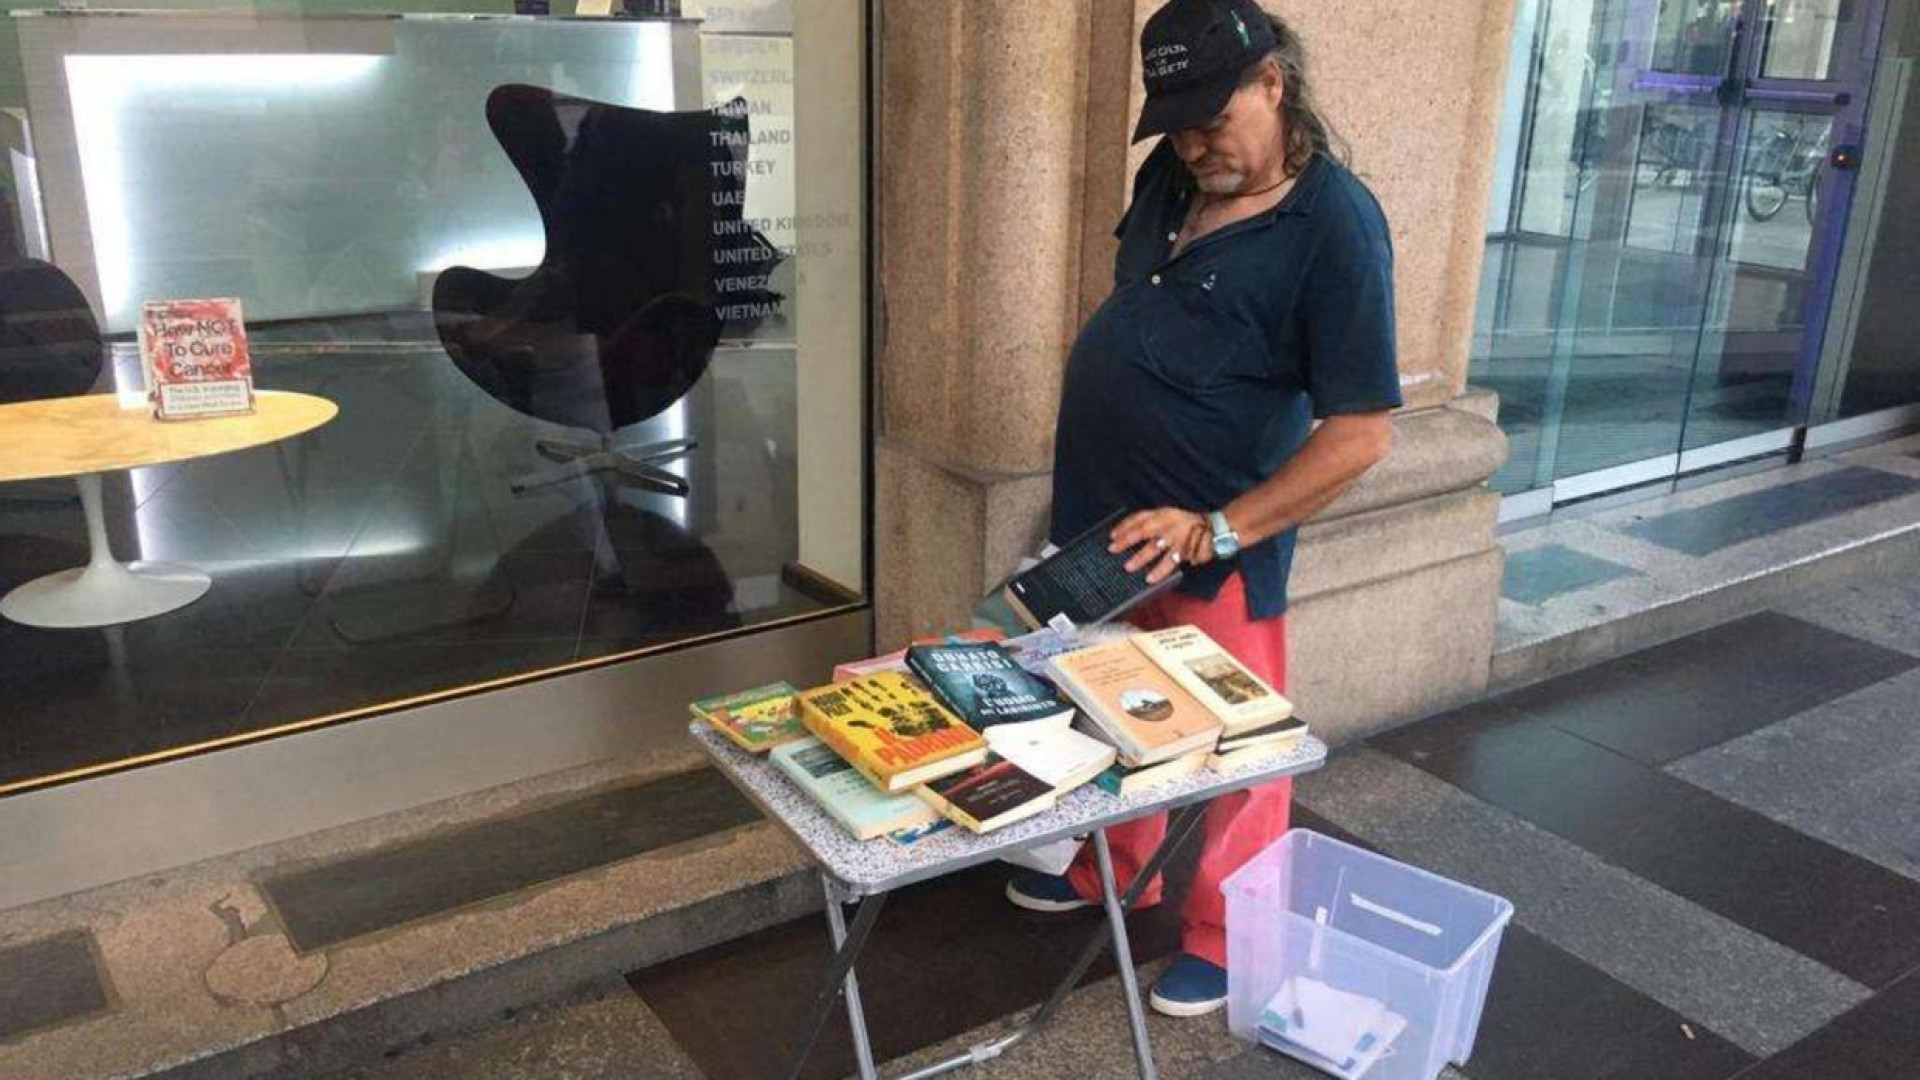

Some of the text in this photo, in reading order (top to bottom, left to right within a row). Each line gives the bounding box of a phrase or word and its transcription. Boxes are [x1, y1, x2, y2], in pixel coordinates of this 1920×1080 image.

[709, 129, 791, 147] THAILAND
[711, 160, 776, 176] TURKEY
[712, 190, 745, 206] UAE
[713, 218, 771, 235] UNITED
[714, 246, 772, 264] UNITED
[715, 301, 785, 320] VIETNAM
[197, 318, 235, 335] NOT
[163, 340, 233, 357] To Cure
[170, 361, 232, 378] Cancer
[932, 649, 1000, 662] DONATO
[936, 659, 1012, 672] CARRISI
[875, 726, 981, 766] PADRINO
